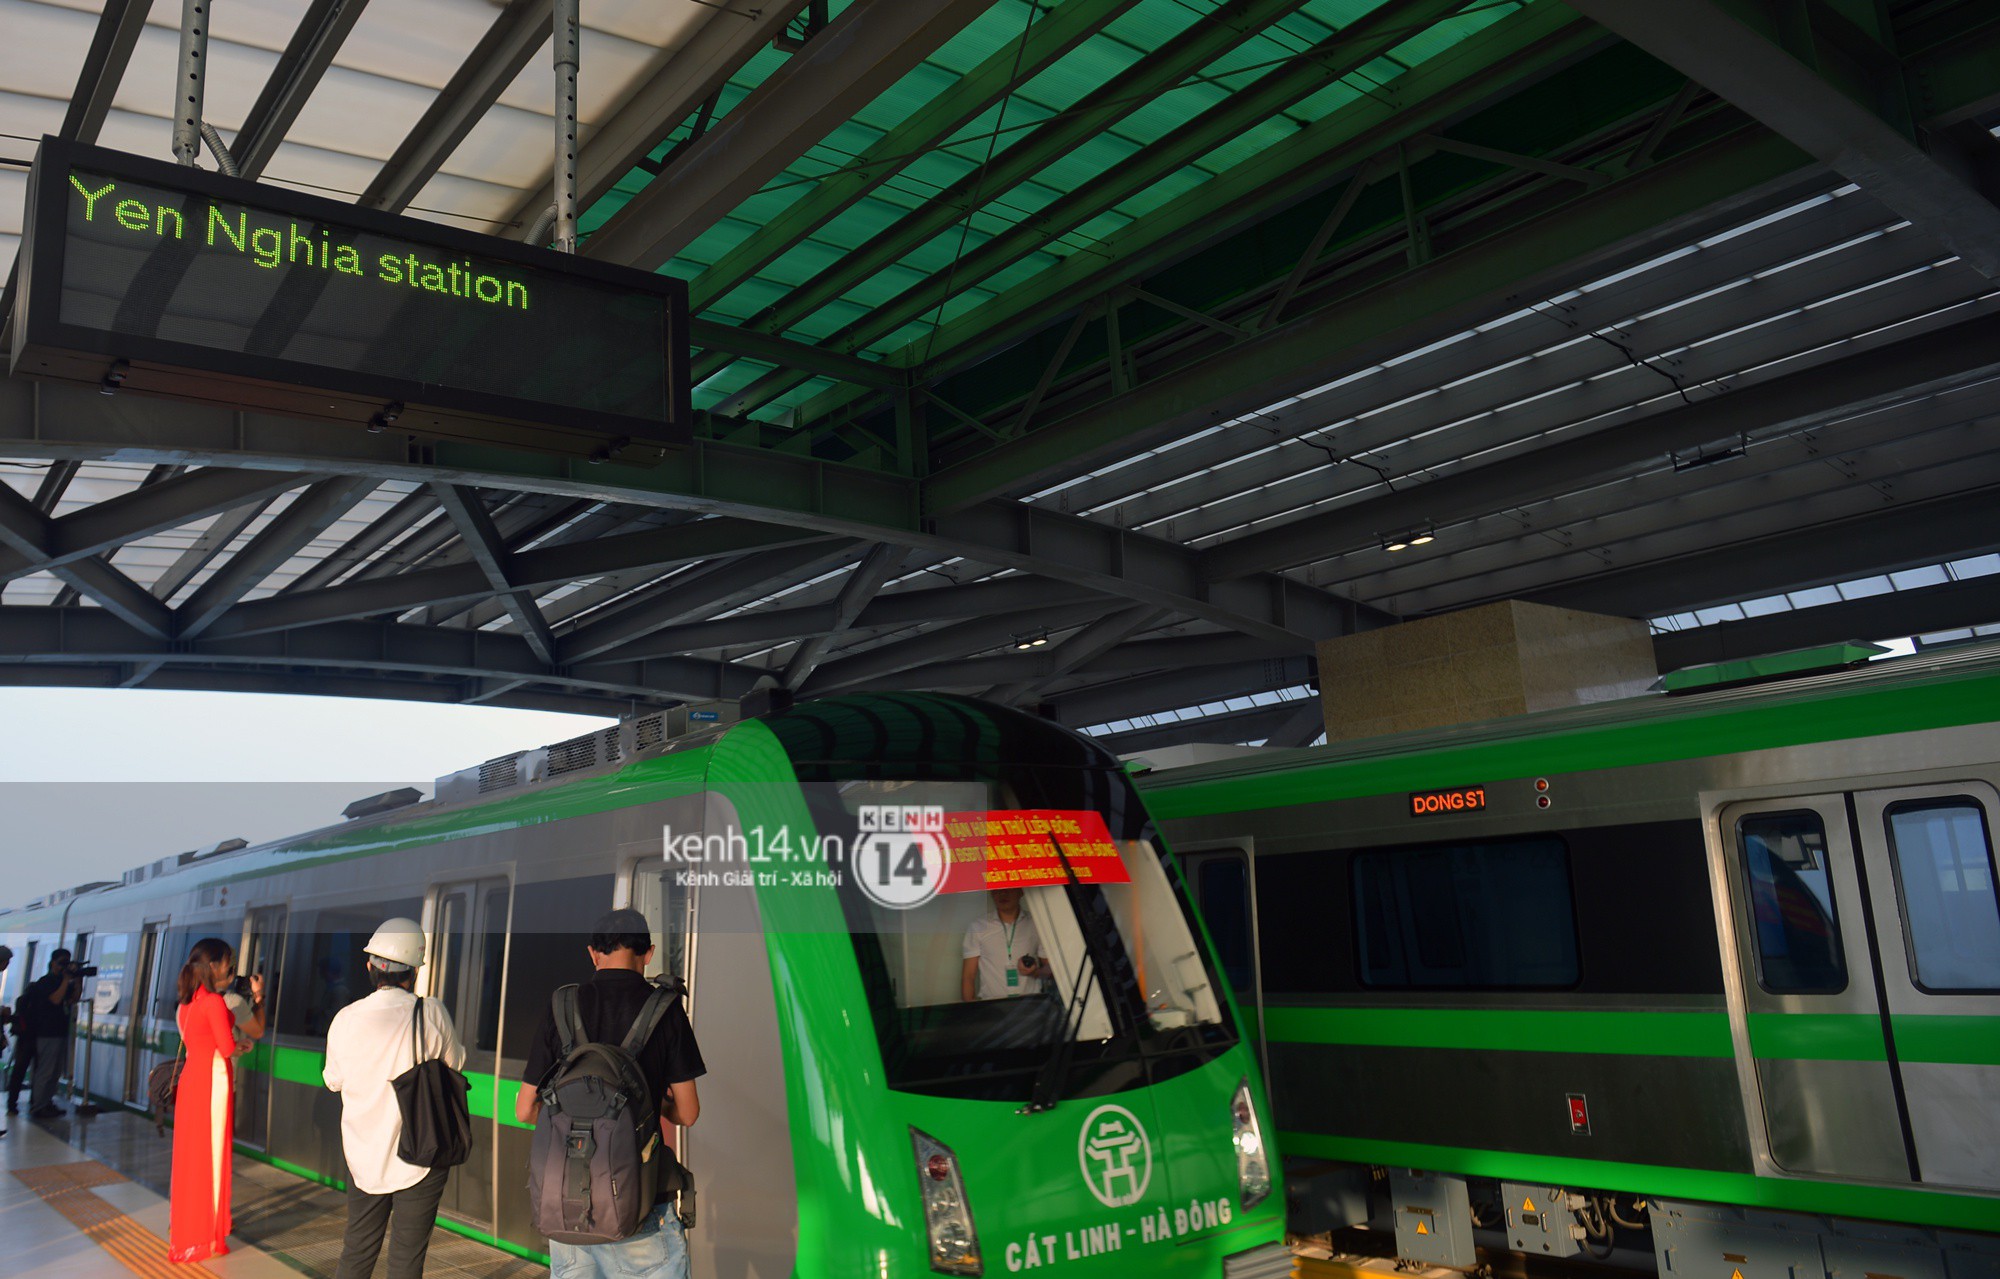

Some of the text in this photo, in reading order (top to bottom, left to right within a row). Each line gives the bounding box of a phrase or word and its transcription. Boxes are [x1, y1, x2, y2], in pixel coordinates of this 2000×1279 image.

[69, 175, 528, 309] Yen Nghia station
[1413, 792, 1465, 814] DONG
[1005, 1232, 1057, 1272] CÁT
[1065, 1222, 1122, 1260] LINH
[1140, 1206, 1173, 1244] HÀ
[1174, 1197, 1232, 1236] ĐÔNG
